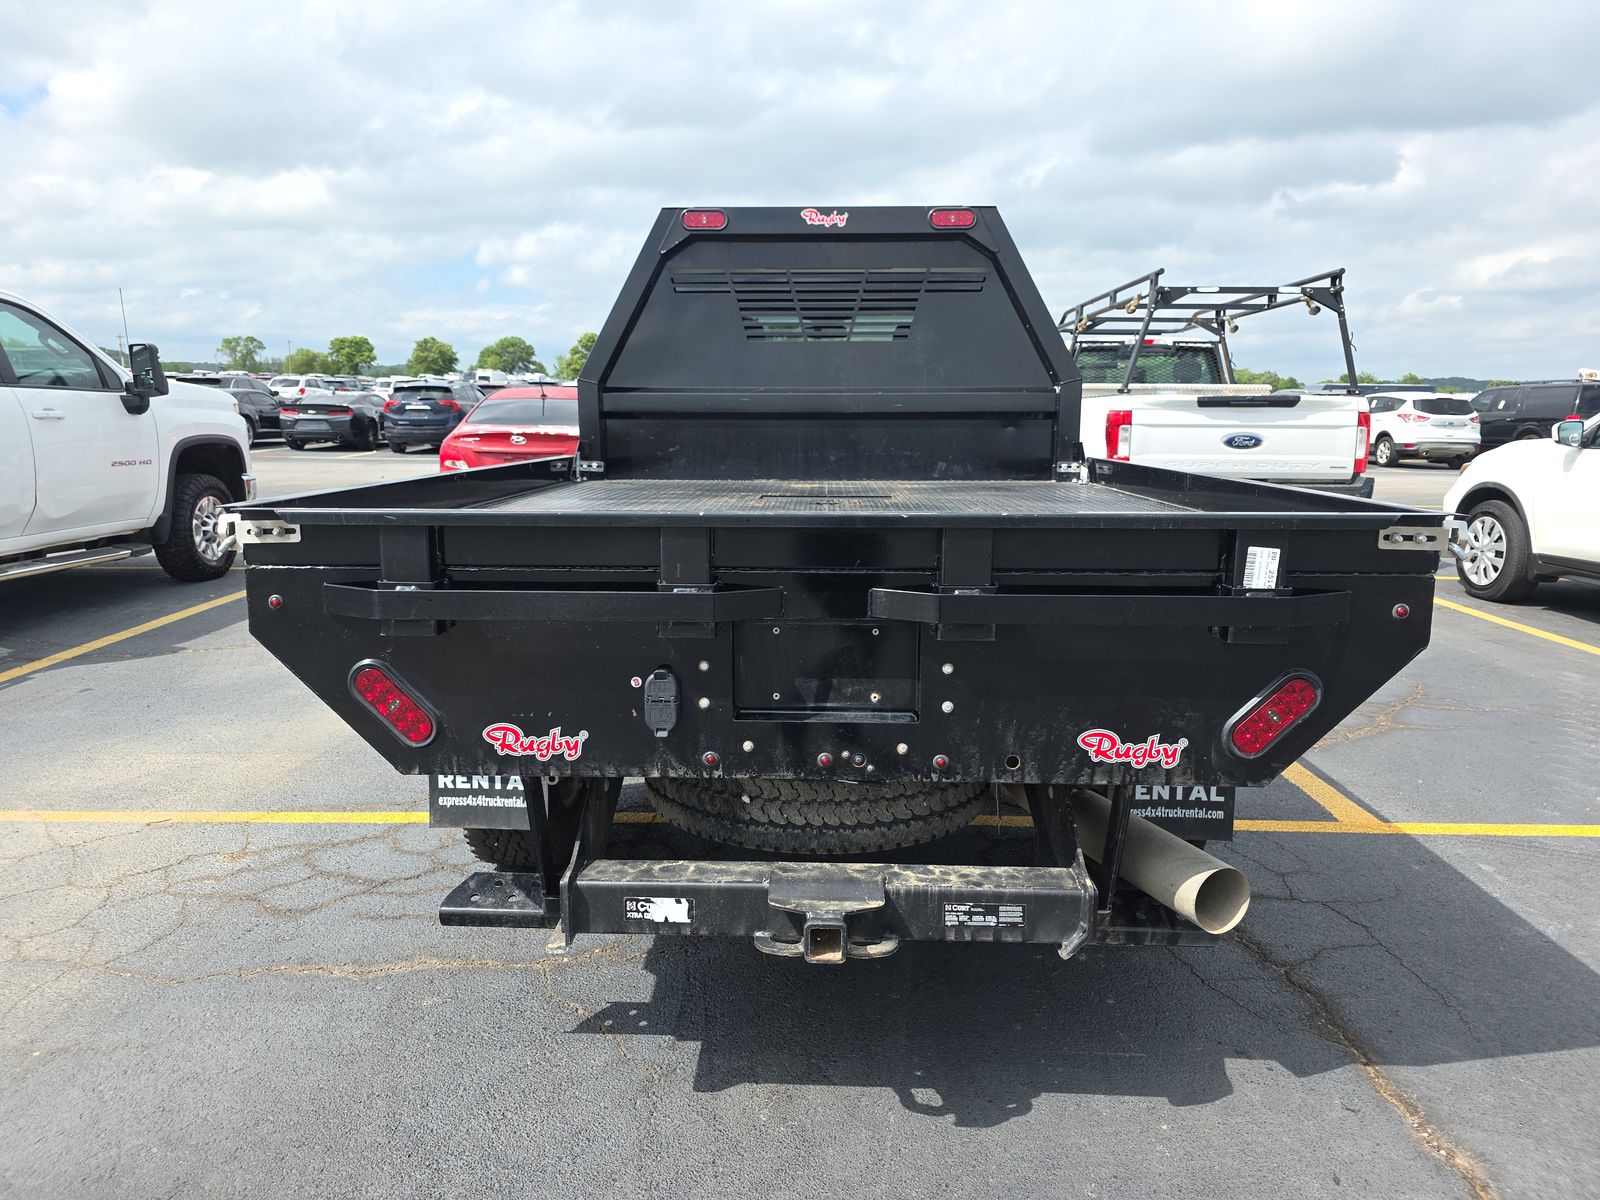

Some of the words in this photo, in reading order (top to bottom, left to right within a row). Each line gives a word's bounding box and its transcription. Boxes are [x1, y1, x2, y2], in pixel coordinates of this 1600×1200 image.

[801, 208, 848, 227] Rugby
[1256, 461, 1321, 470] DUTY
[482, 722, 584, 762] Rugby
[1077, 728, 1181, 769] Rugby
[437, 774, 524, 790] RENTA
[438, 795, 527, 808] express4x4truckrental.
[1135, 784, 1225, 802] ENTAL
[1130, 806, 1224, 819] ress4x4truckrental.com
